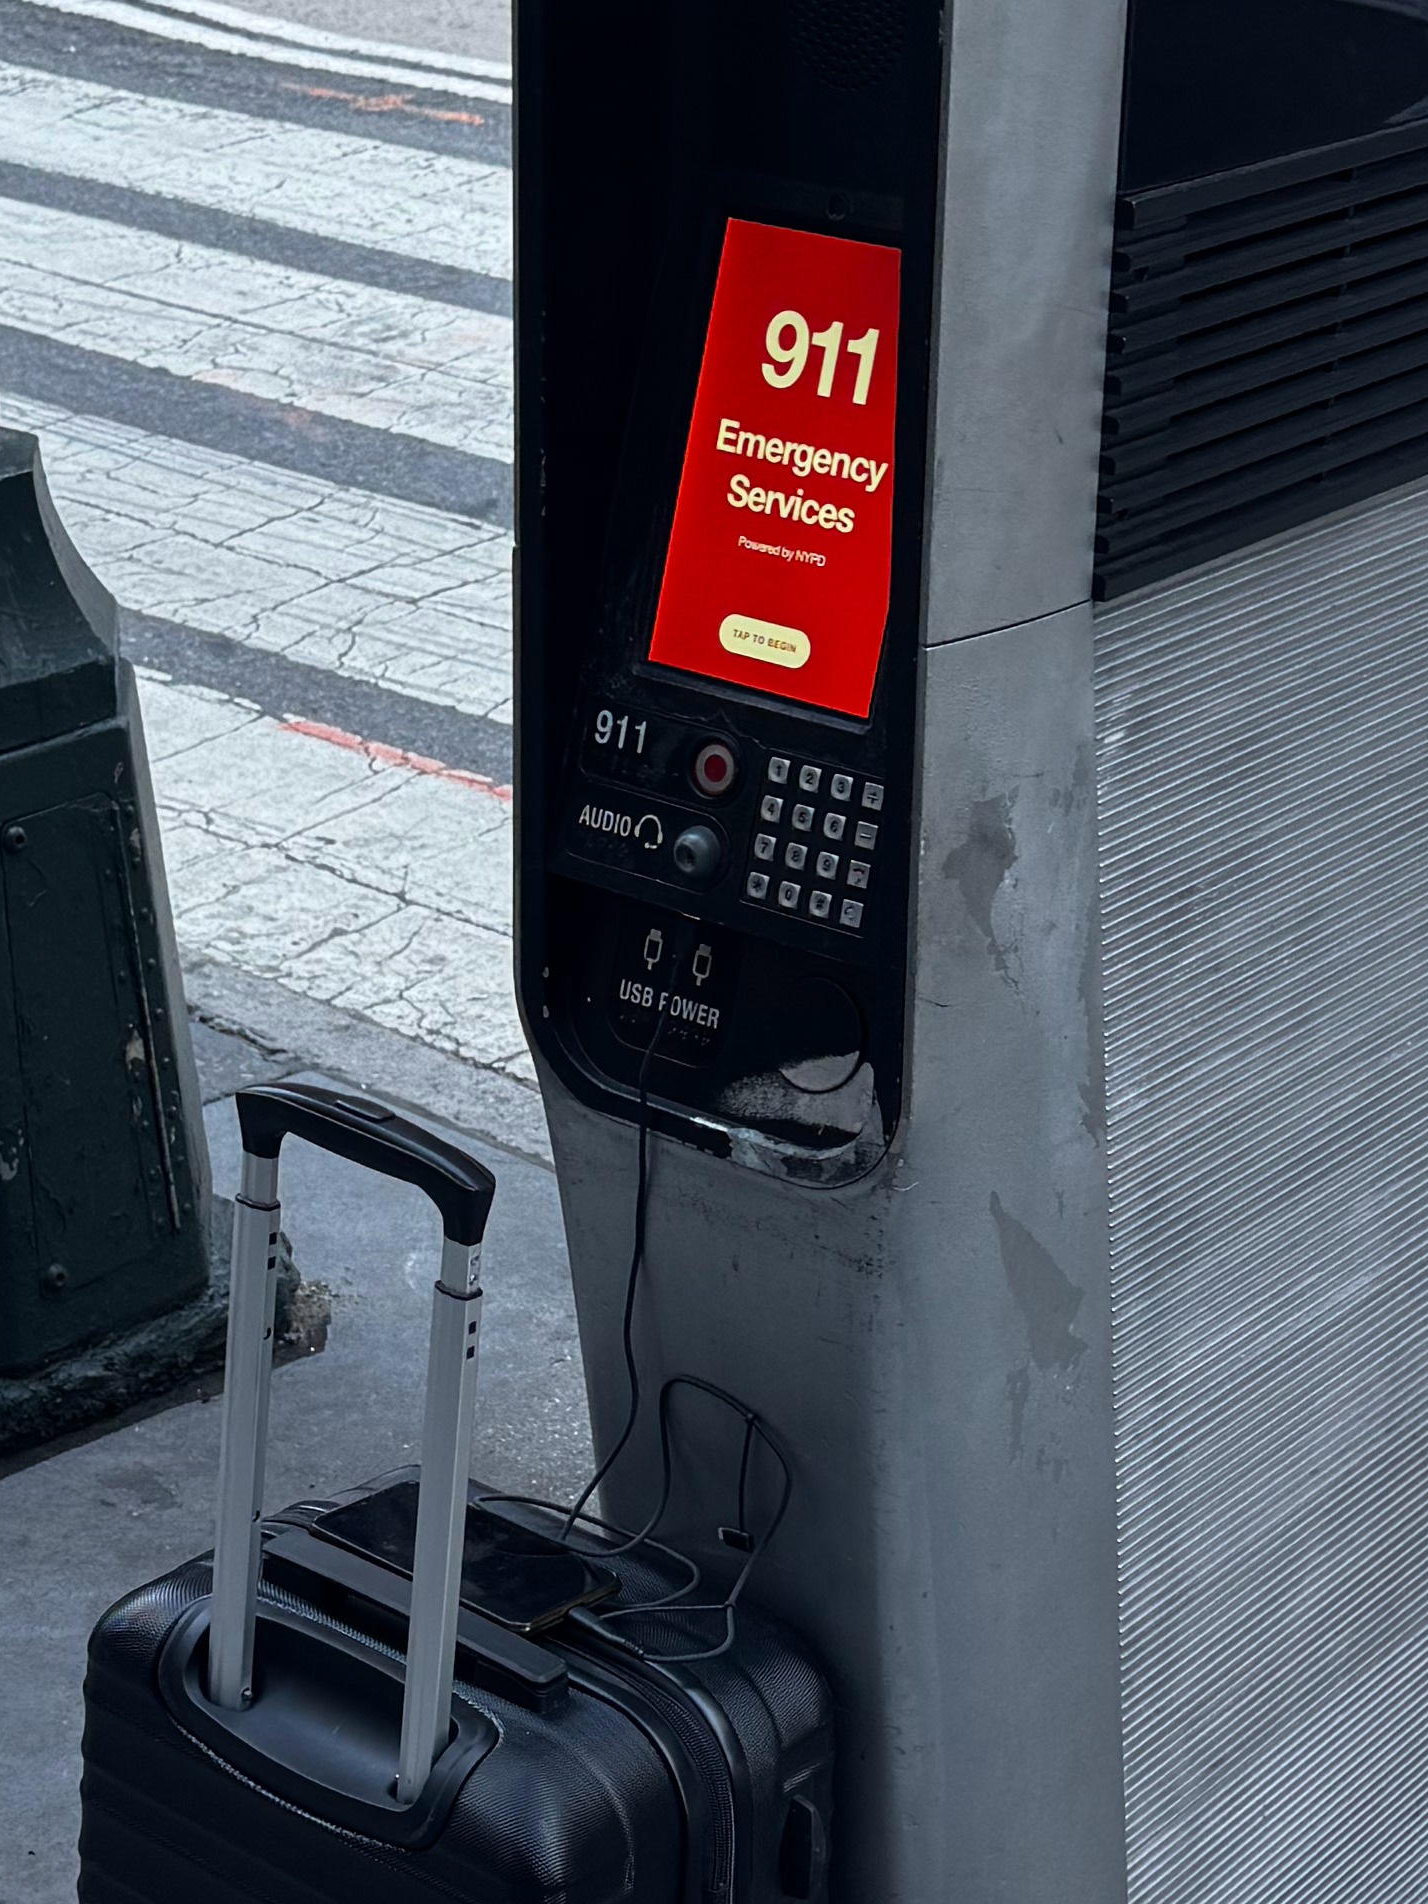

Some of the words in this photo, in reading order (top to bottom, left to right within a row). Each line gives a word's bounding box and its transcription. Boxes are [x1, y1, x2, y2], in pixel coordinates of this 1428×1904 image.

[761, 309, 880, 405] 911
[716, 418, 888, 493] Emergency
[726, 473, 856, 533] Services
[738, 535, 782, 556] Powered
[781, 546, 795, 562] by
[795, 549, 827, 567] NYPD
[733, 629, 750, 641] TAP
[752, 633, 765, 645] TO
[767, 638, 797, 653] BEGIN
[594, 709, 647, 754] 911
[804, 771, 814, 785] 2
[837, 781, 845, 794] 3
[578, 804, 632, 837] AUDIO
[761, 841, 769, 854] 7
[619, 978, 654, 1007] USB
